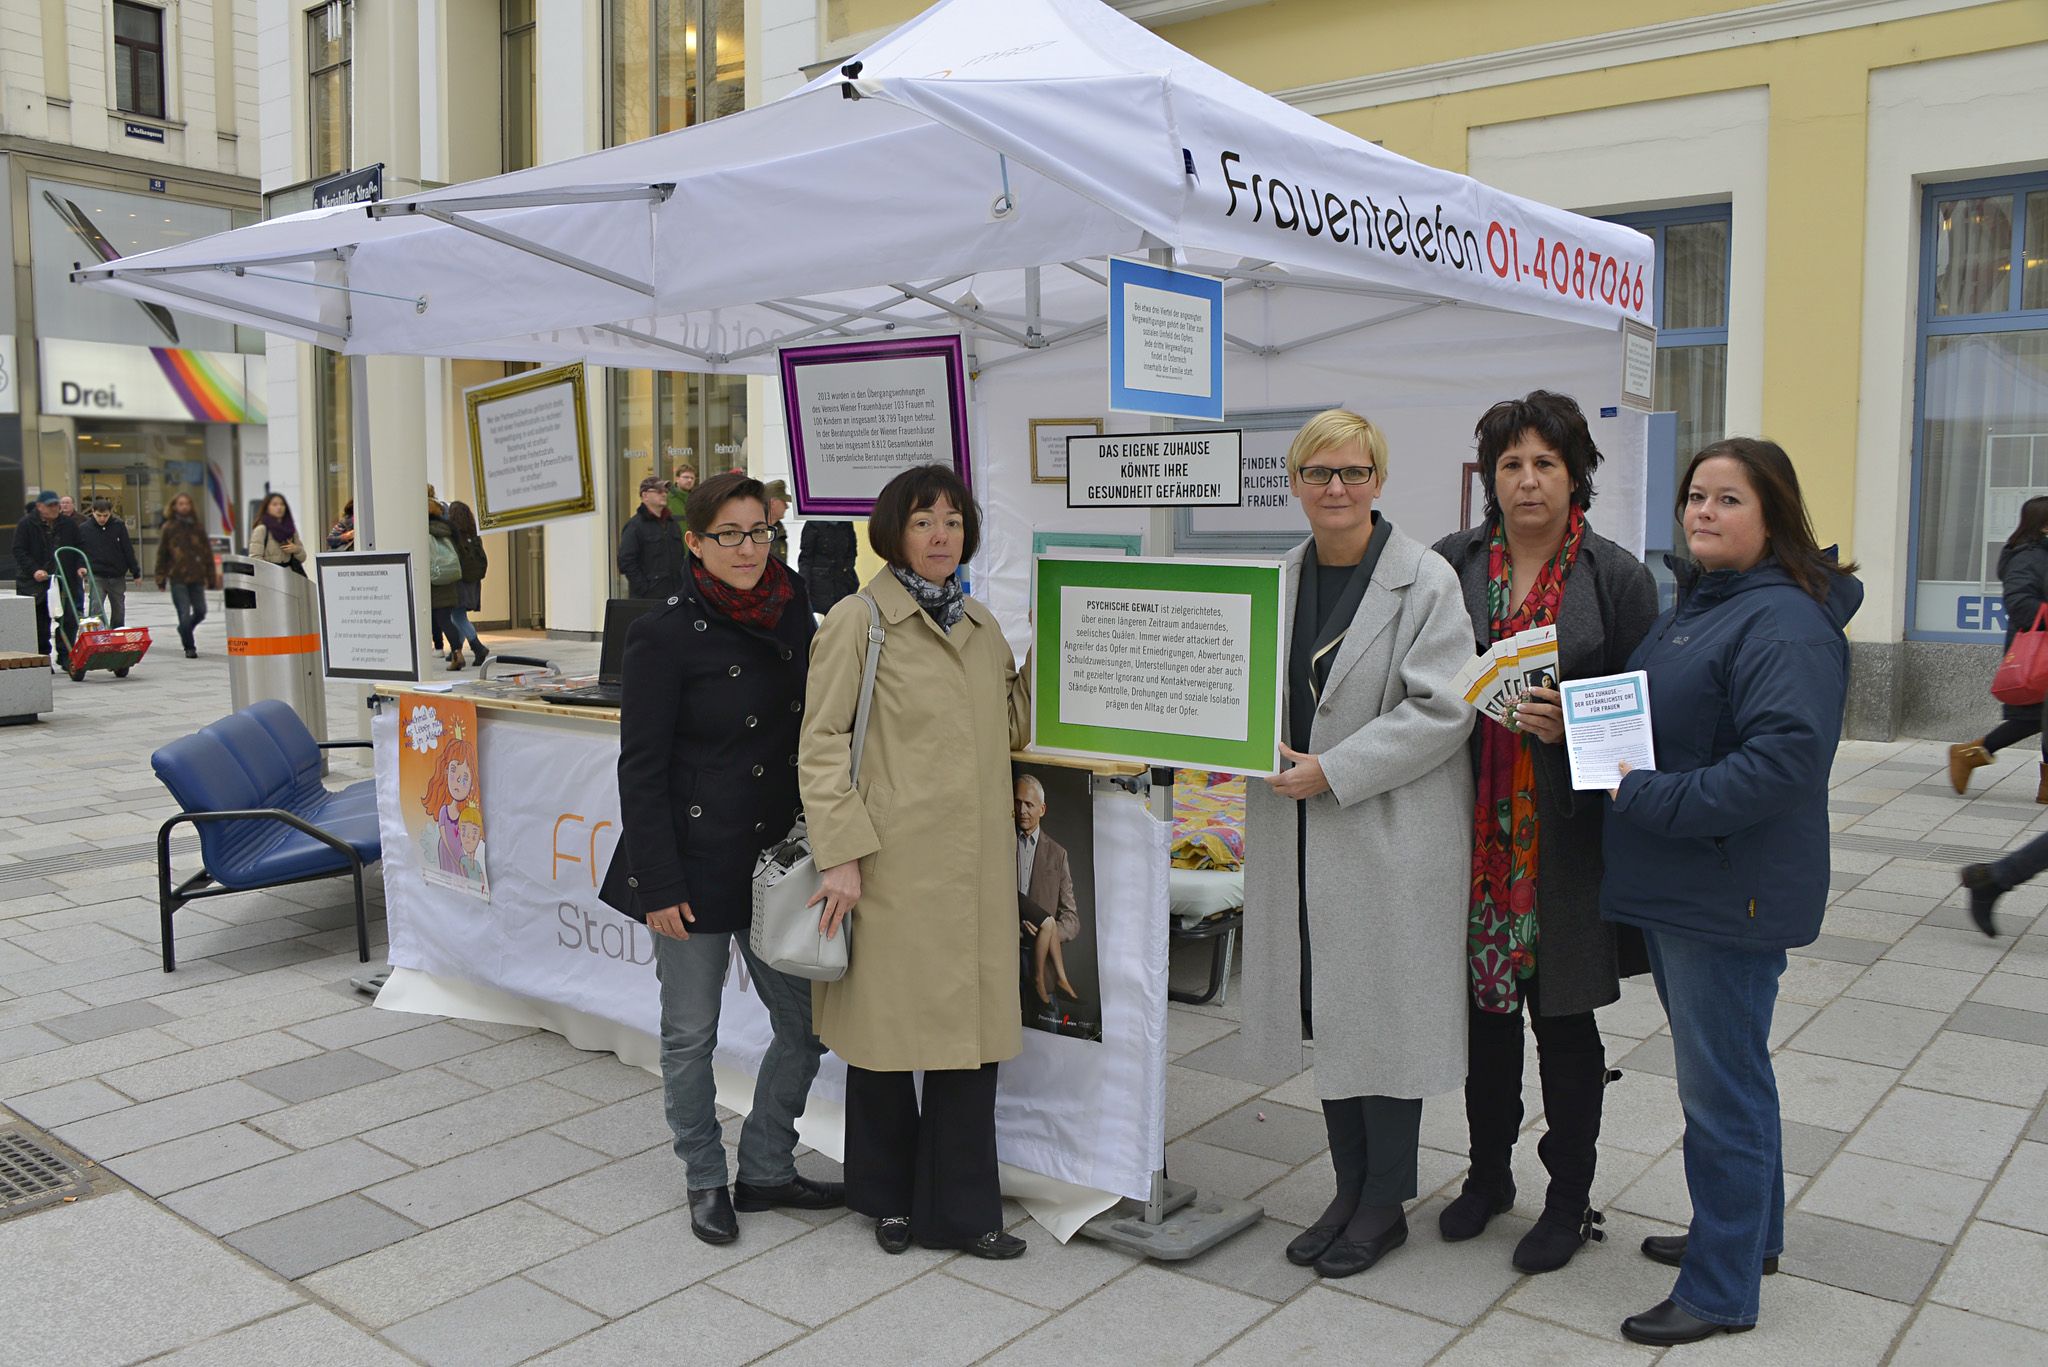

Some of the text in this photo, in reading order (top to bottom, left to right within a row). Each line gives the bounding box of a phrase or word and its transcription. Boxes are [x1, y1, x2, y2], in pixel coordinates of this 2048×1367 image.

[1220, 150, 1644, 312] Frauentelefon 01-4087066
[62, 382, 123, 408] Drei.
[818, 392, 830, 400] 2013
[831, 391, 849, 399] wurden
[867, 388, 925, 399] Übergangswohnungen
[822, 404, 840, 412] Vereins
[858, 402, 894, 411] Frauenhäuser
[894, 401, 904, 409] 103
[925, 400, 935, 408] mit
[851, 415, 877, 425] insgesamt
[878, 414, 897, 423] 38.799
[898, 414, 914, 423] Tagen
[915, 413, 936, 421] betreut.
[831, 428, 870, 438] Beratungsstelle
[898, 426, 935, 434] Frauenhäuser
[845, 441, 870, 450] insgesamt
[888, 439, 934, 448] Gesamtkontakten
[1099, 442, 1210, 458] DAS EIGENE ZUHAUSE
[836, 454, 864, 463] persönliche
[865, 453, 895, 462] Beratungen
[896, 452, 934, 462] stattgefunden.
[1242, 456, 1277, 470] FINDEN
[1121, 462, 1188, 478] KÖNNTE IHRE
[1088, 482, 1220, 498] GESUNDHEIT GEFÄHRDEN!
[1248, 494, 1288, 507] FRAUEN!
[1087, 601, 1129, 611] PSYCHISCHE
[1132, 603, 1159, 613] GEWALT
[1171, 606, 1223, 618] zielgerichtetes,
[1082, 615, 1228, 633] über einen längeren Zeitraum andauerndes,
[1077, 629, 1233, 646] seelisches Quälen. Immer wieder attackiert der
[1064, 641, 1246, 663] Angreifer das Opfer mit Erniedrigungen, Abwertungen,
[1067, 655, 1243, 676] Schuldzuweisungen, Unterstellungen oder aber auch
[1074, 670, 1234, 691] mit gezielter Ignoranz und Kontaktverweigerung.
[1068, 682, 1240, 705] Ständige Kontrolle, Drohungen und soziale Isolation
[1586, 696, 1623, 706] GEFÄHRLICHSTE
[1596, 689, 1616, 697] ZUHAUSE
[1106, 700, 1199, 716] prägen den Alltag der Opfer.
[1602, 704, 1620, 712] FRAUEN
